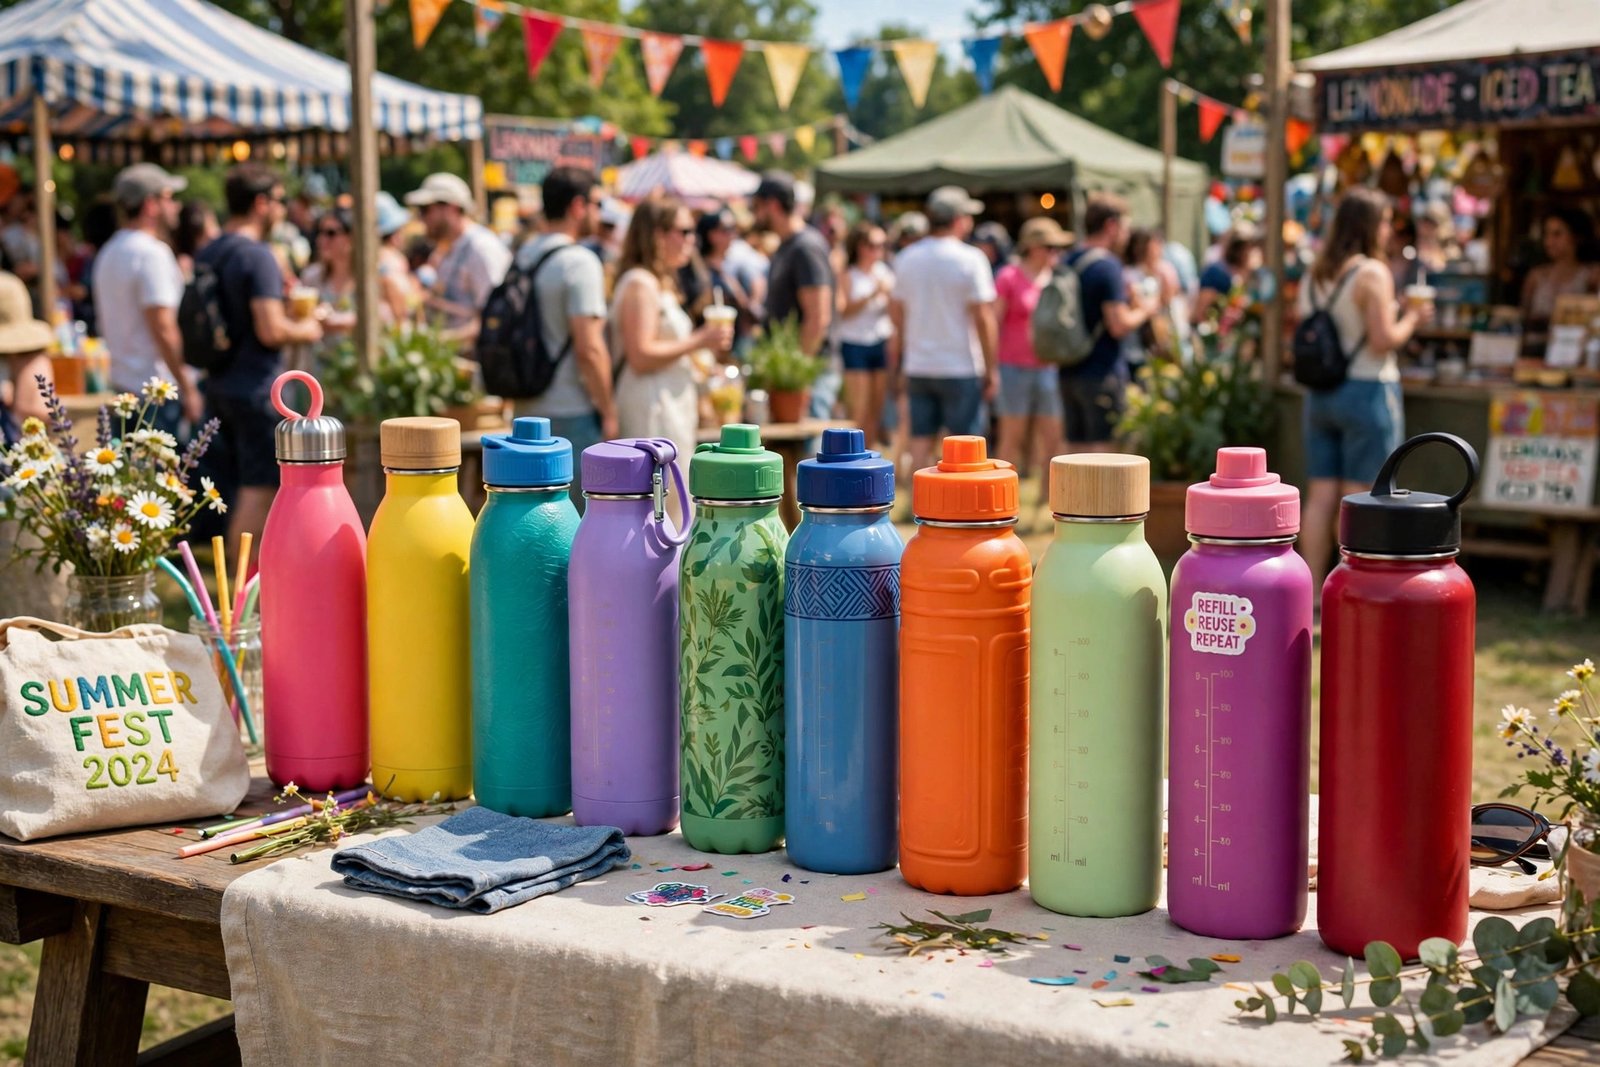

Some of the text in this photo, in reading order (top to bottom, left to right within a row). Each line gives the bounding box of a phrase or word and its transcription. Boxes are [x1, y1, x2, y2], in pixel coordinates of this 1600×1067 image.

[1327, 61, 1596, 121] LEMONADE ICED TEA
[1198, 598, 1237, 616] REFILL
[1198, 615, 1236, 633] REUSE
[1196, 631, 1240, 649] REPEAT
[20, 671, 198, 717] SUMMER
[69, 709, 173, 751] FEST
[83, 748, 180, 790] 2024
